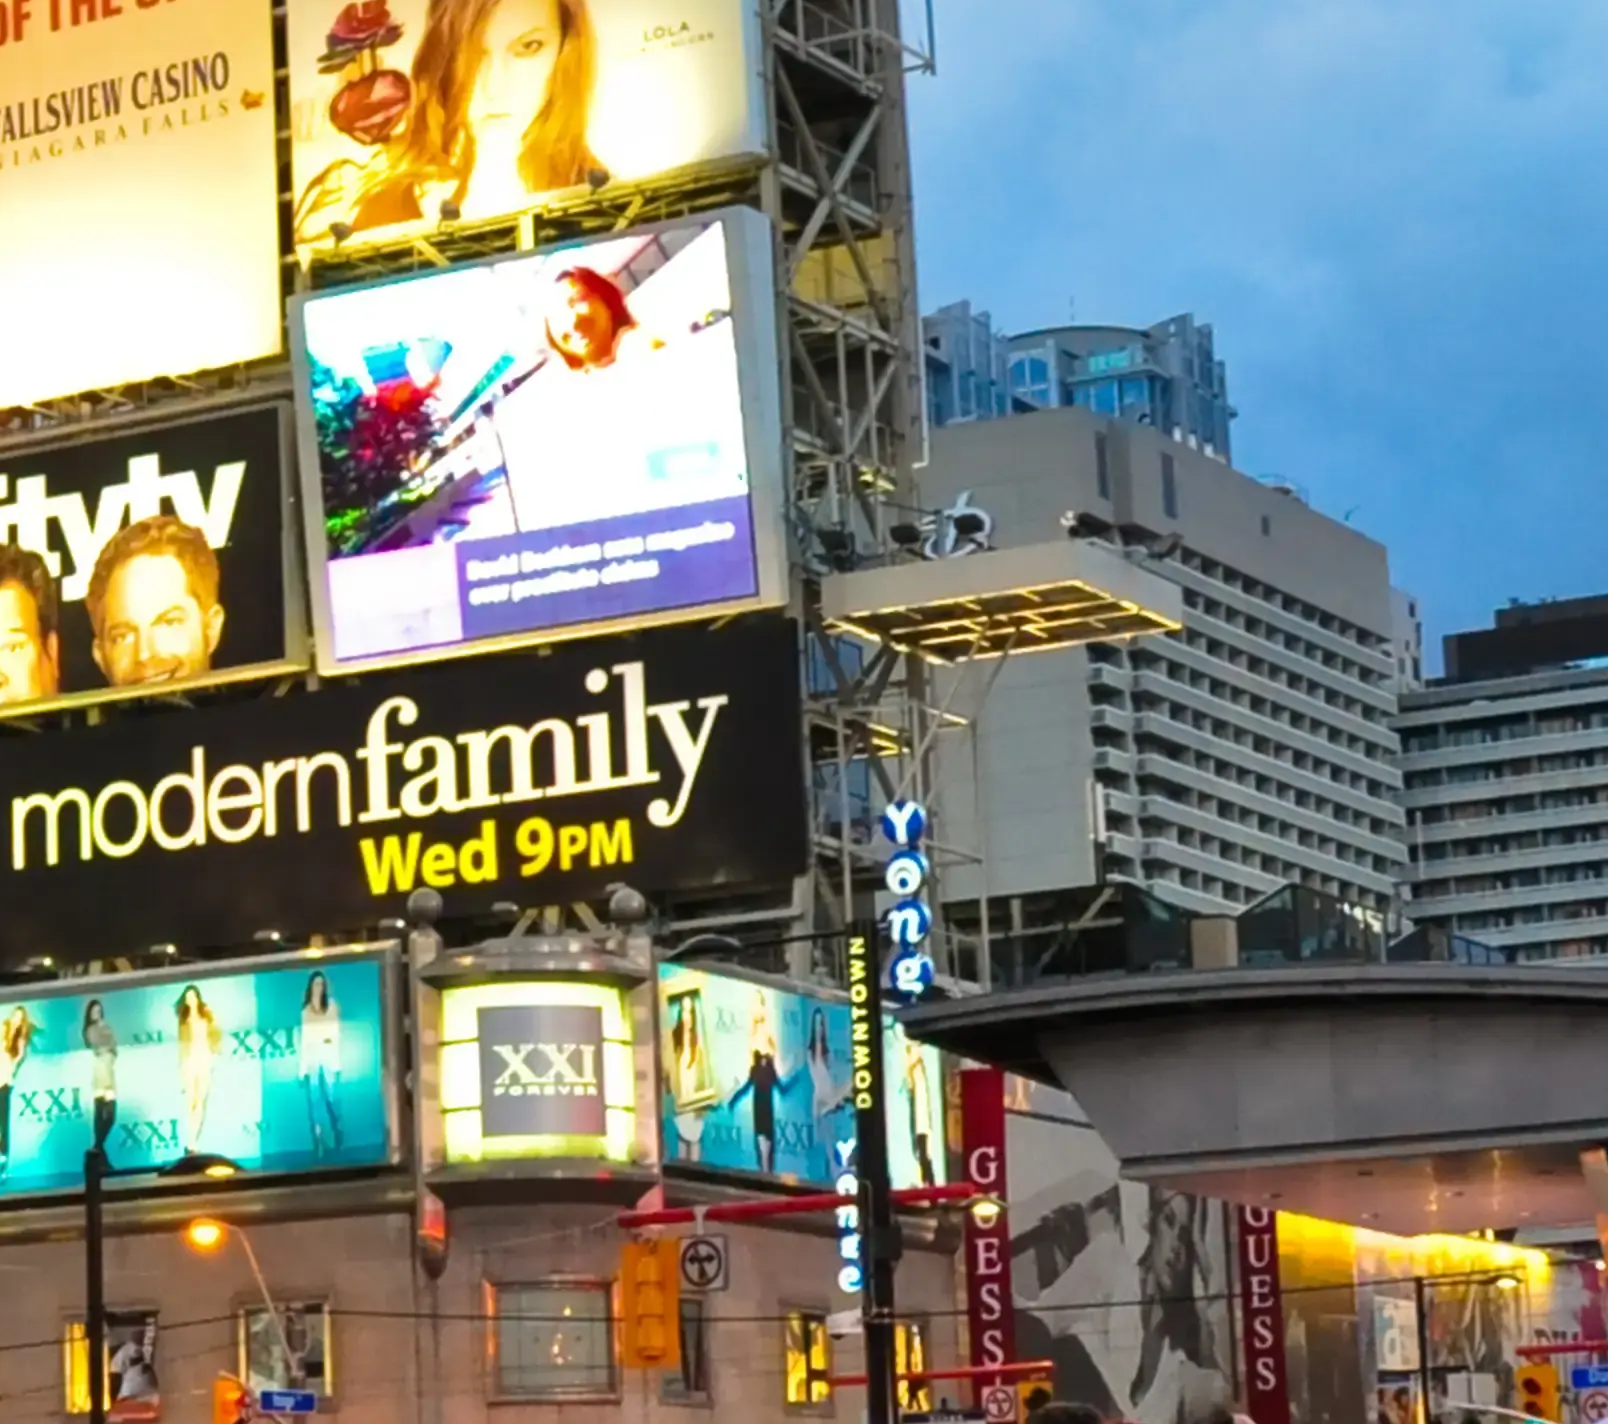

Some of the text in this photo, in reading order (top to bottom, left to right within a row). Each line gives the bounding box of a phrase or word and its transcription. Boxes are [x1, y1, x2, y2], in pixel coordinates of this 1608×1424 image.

[642, 20, 689, 43] LOLA
[130, 51, 230, 111] CASINO
[141, 99, 231, 137] FALLS
[360, 815, 633, 896] Wed 9PM
[885, 798, 930, 1004] Yong
[230, 1027, 297, 1055] XXI
[848, 935, 874, 1111] DOWNTOWN
[491, 1042, 597, 1085] XXI
[18, 1087, 83, 1117] XXI
